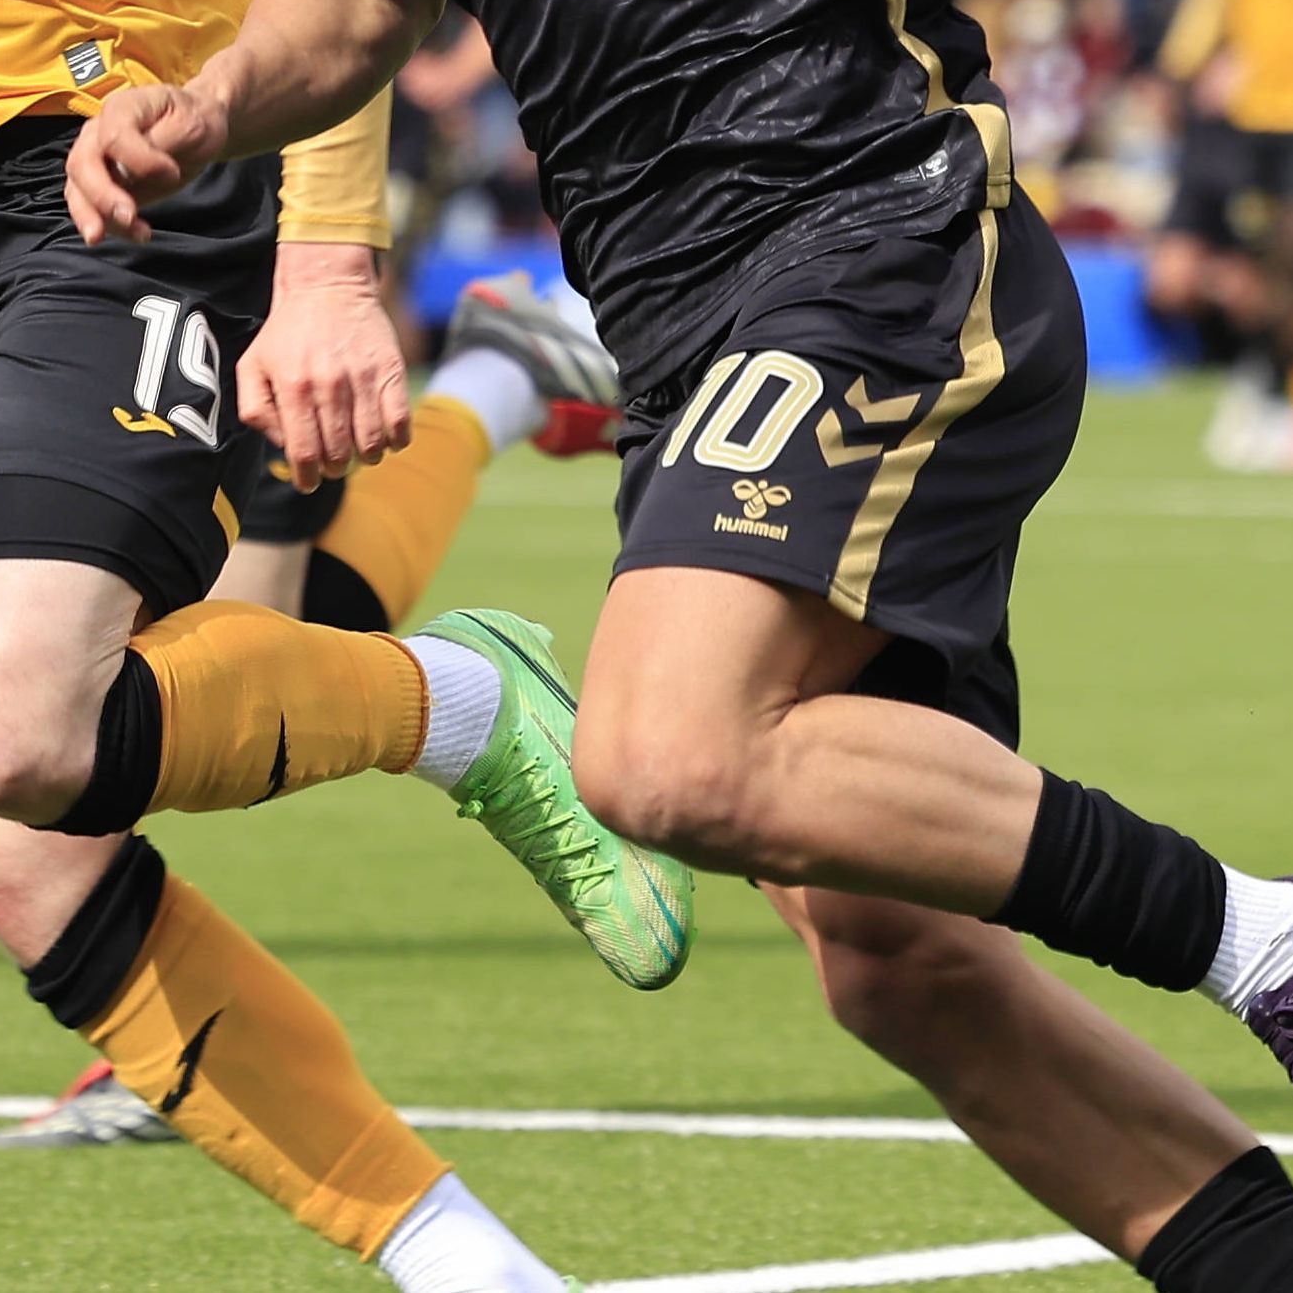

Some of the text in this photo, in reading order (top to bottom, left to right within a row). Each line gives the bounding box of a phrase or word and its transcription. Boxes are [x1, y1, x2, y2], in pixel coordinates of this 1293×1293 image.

[132, 294, 221, 449] 19
[661, 349, 824, 474] 10
[713, 512, 789, 542] hummel
